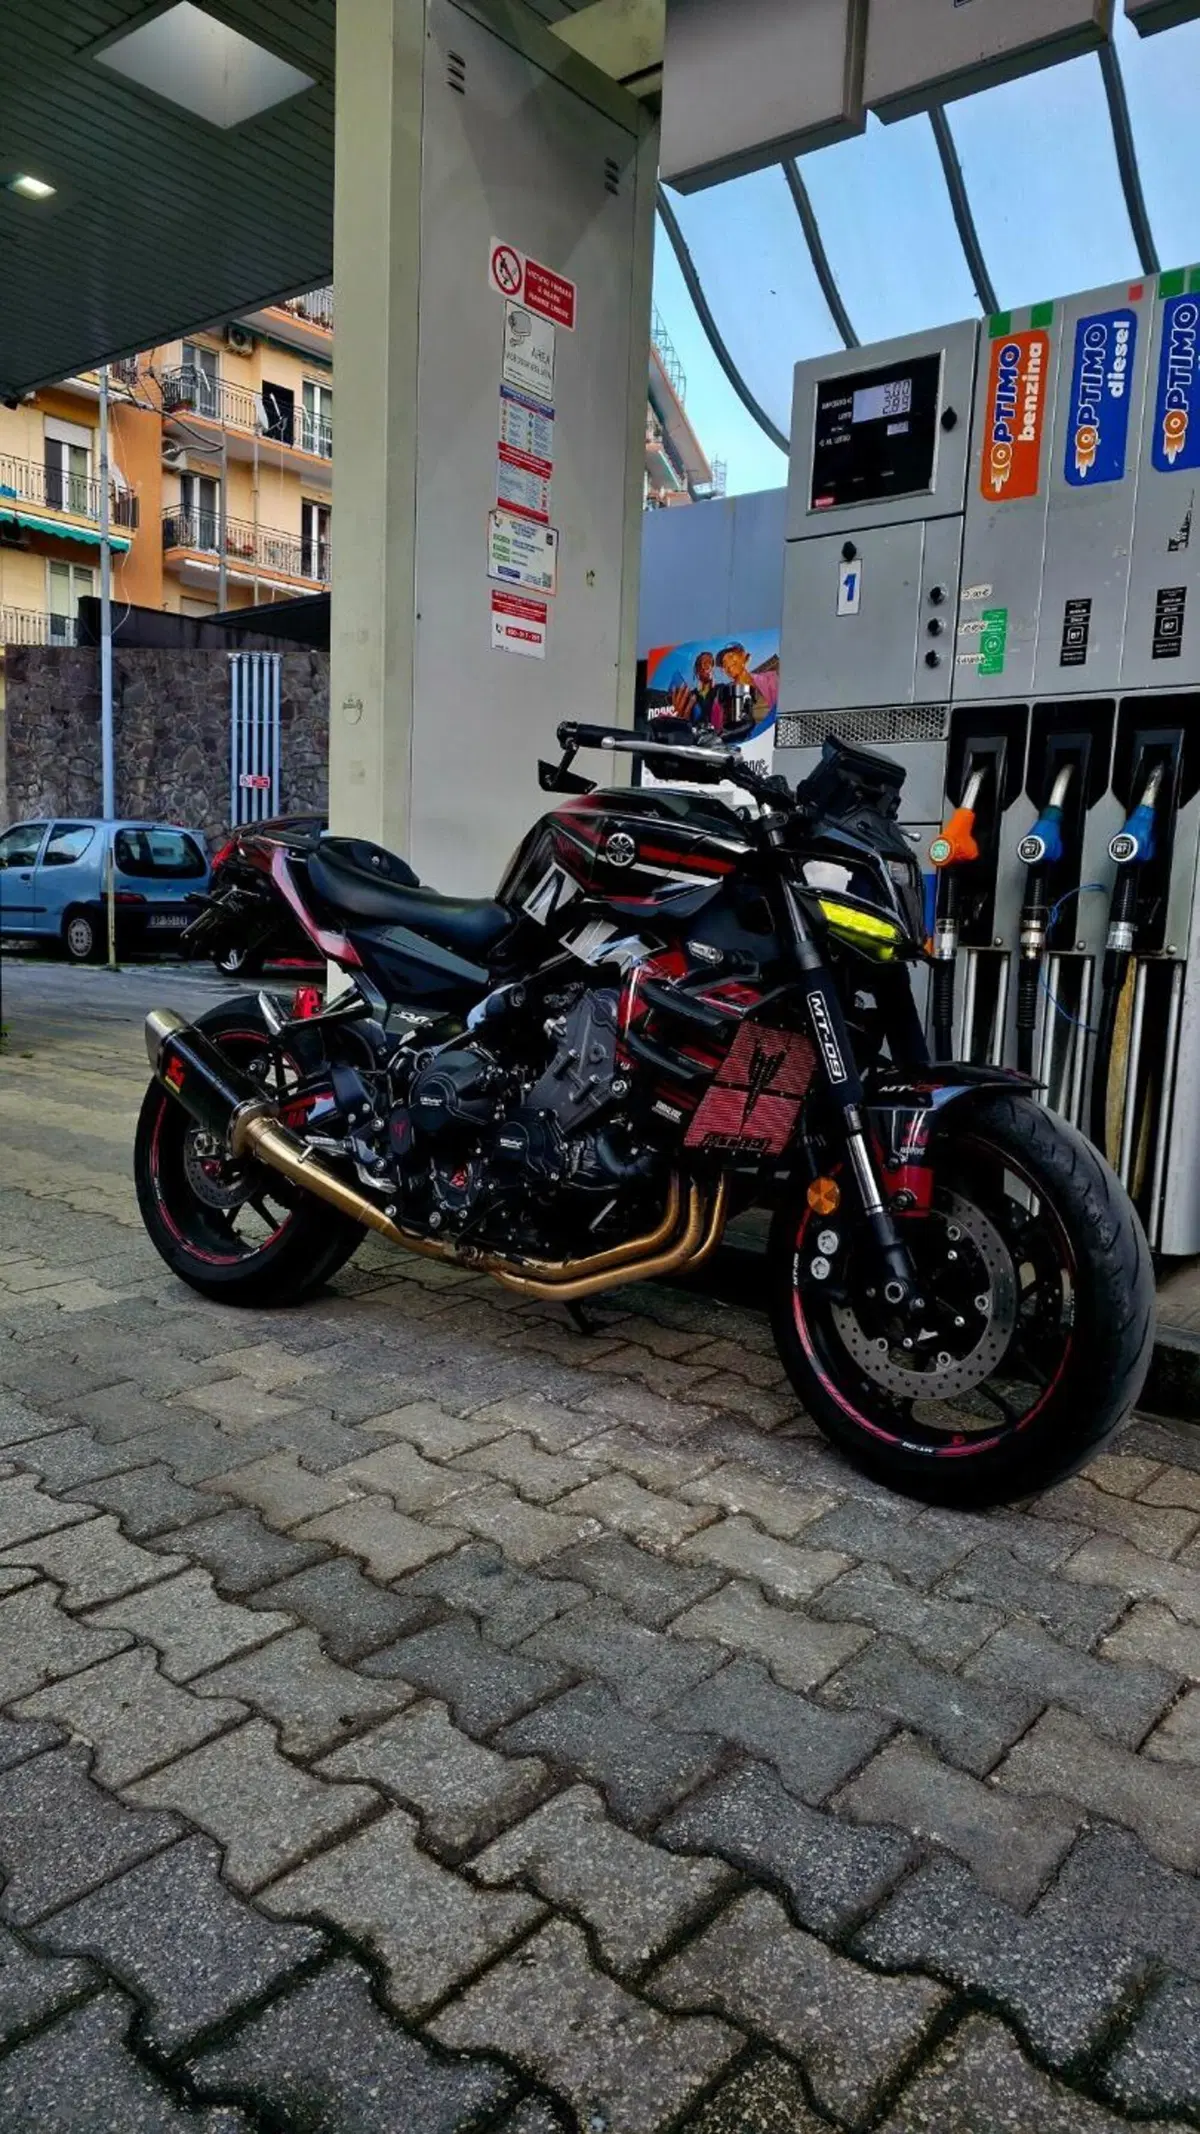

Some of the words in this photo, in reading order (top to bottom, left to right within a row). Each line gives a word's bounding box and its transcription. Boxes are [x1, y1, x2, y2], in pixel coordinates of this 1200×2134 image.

[990, 343, 1022, 468] OPTIMO
[1018, 342, 1043, 441] benzina
[1075, 323, 1107, 453] OPTIMO
[1107, 320, 1130, 398] diesel
[1162, 303, 1199, 438] OPTIMO
[843, 573, 857, 602] 1
[811, 997, 843, 1077] MT-09
